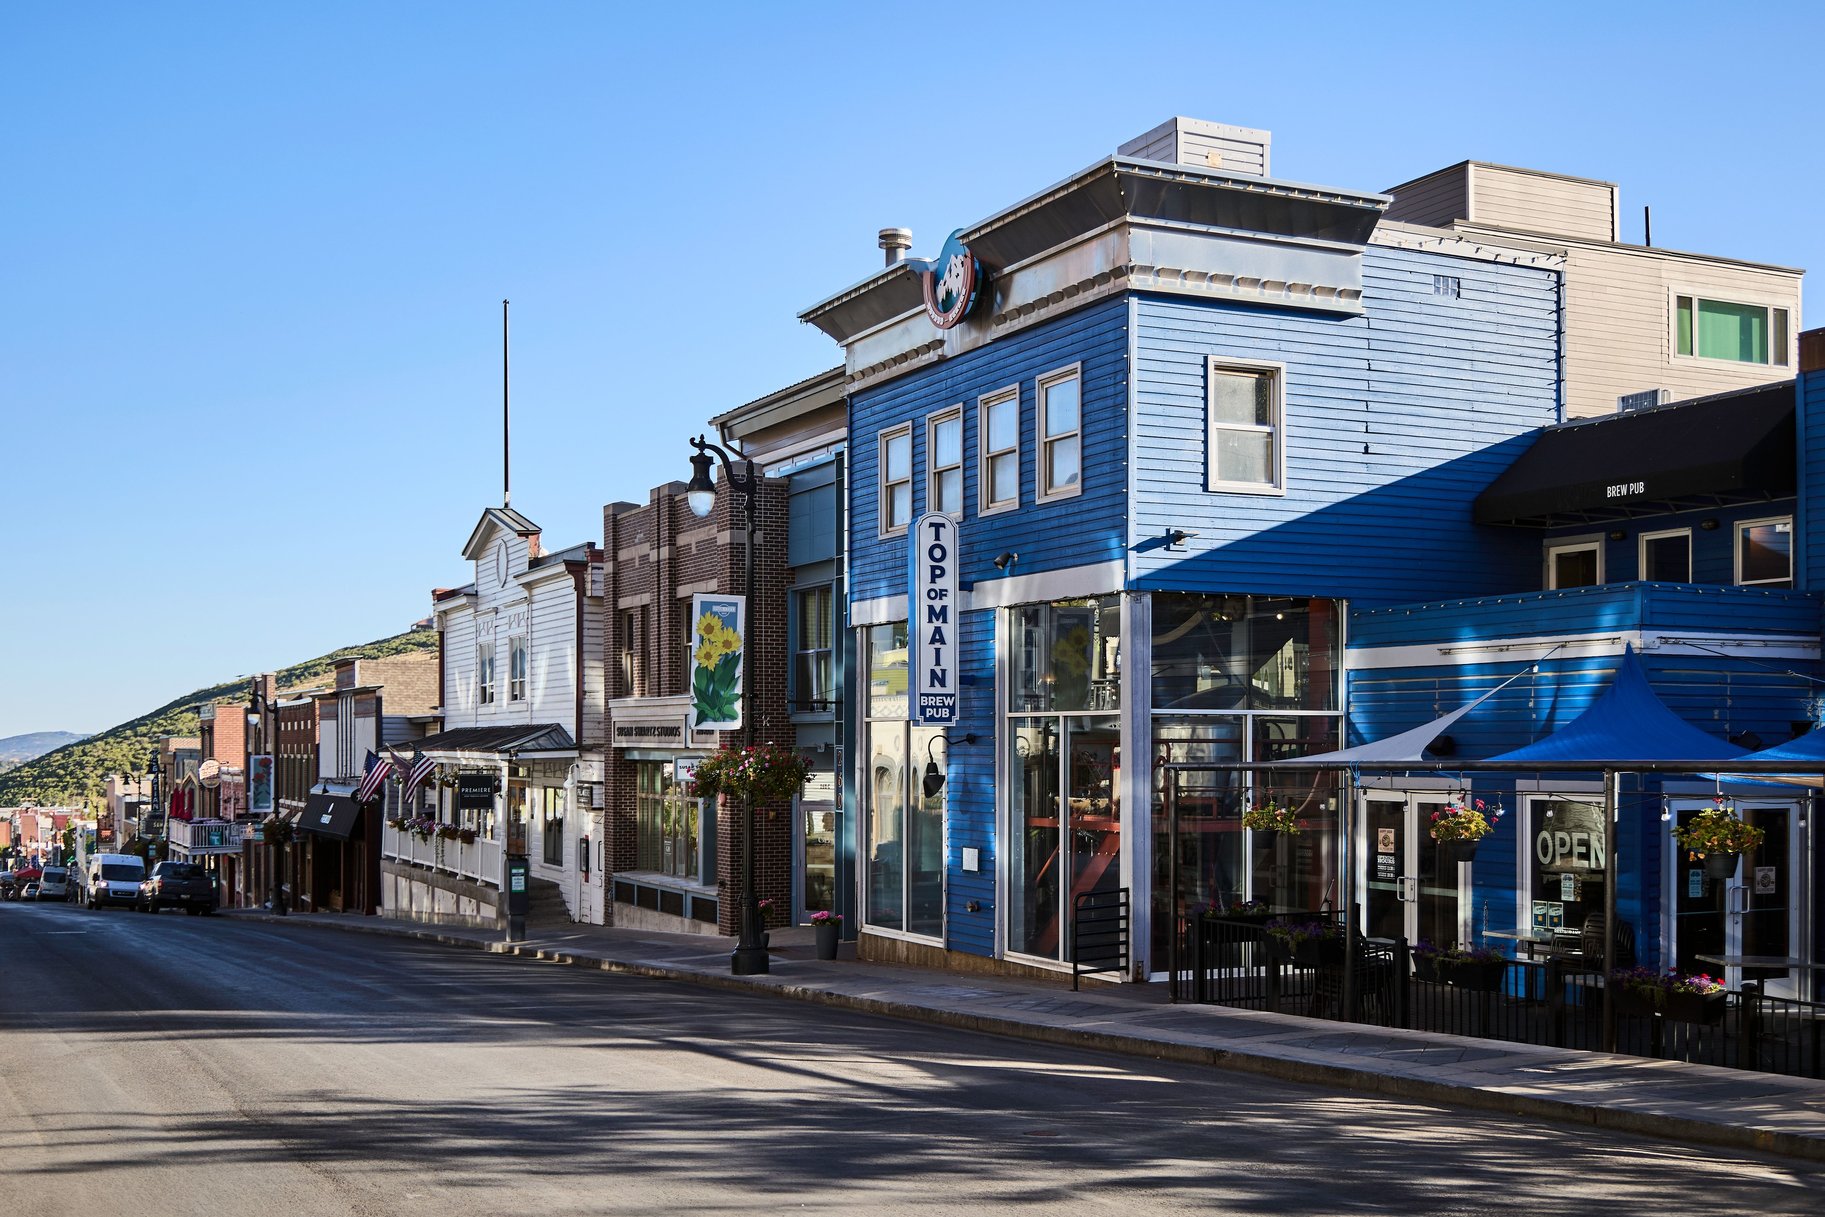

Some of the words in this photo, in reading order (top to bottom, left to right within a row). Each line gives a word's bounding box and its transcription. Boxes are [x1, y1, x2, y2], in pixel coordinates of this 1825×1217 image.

[1607, 484, 1628, 498] BREW
[1630, 481, 1645, 495] PUB
[927, 522, 947, 584] TOP
[926, 588, 948, 601] OF
[926, 604, 949, 688] MAIN
[920, 696, 955, 707] BREW
[925, 708, 950, 718] PUB
[656, 726, 681, 737] STUDIOS
[1536, 830, 1606, 869] OPEN
